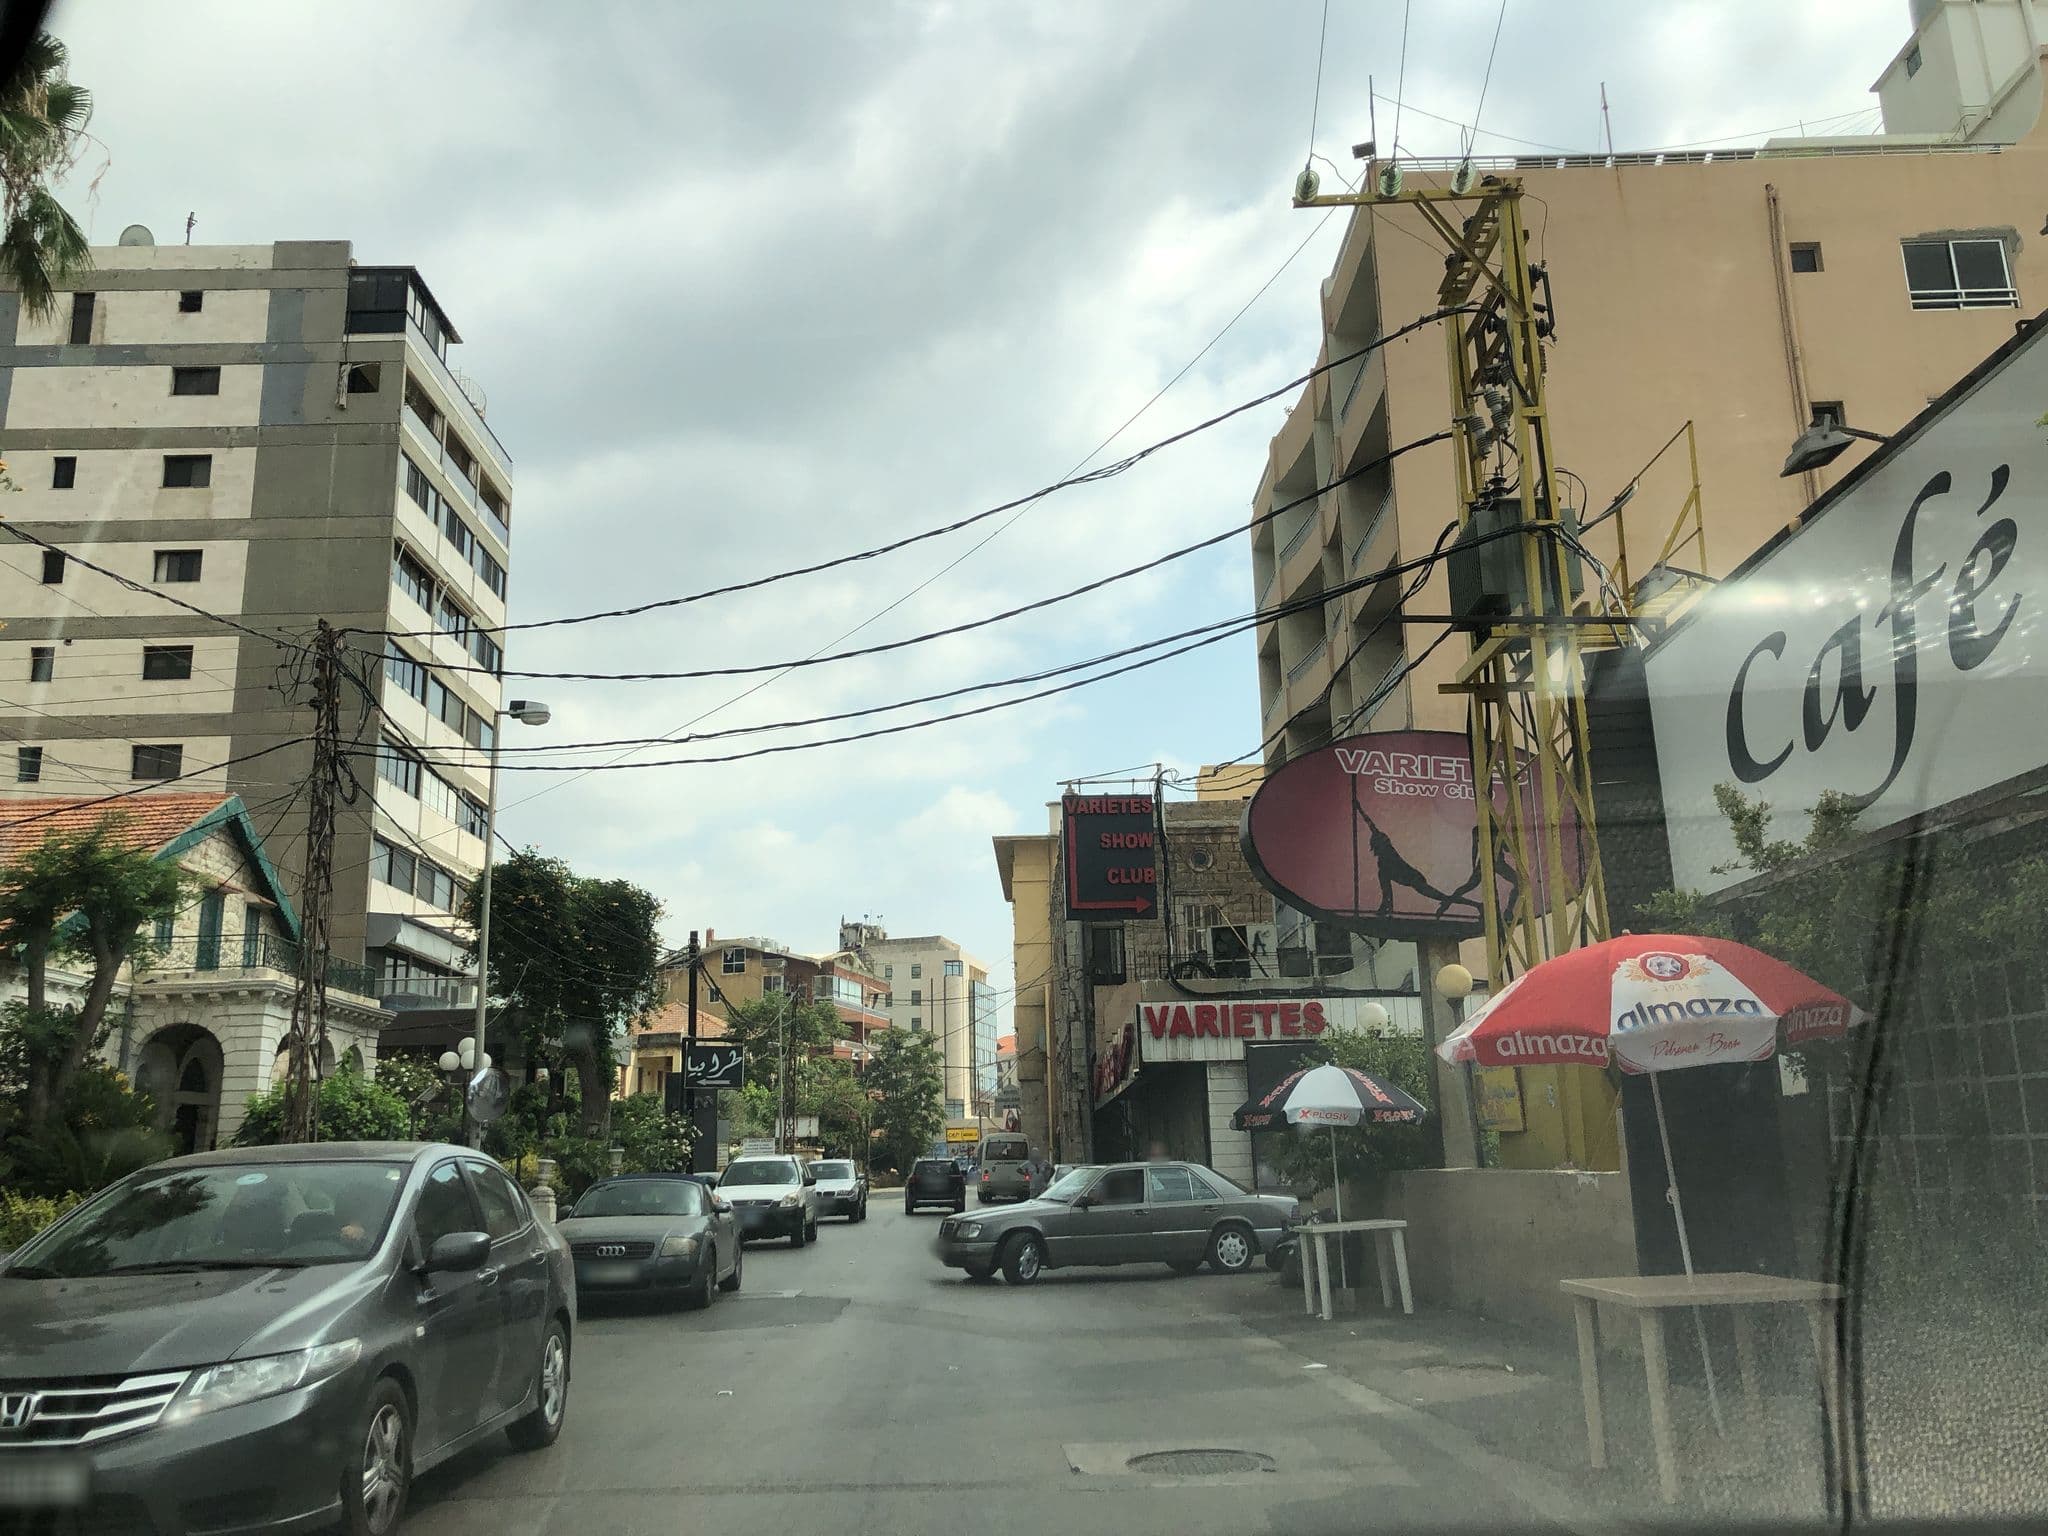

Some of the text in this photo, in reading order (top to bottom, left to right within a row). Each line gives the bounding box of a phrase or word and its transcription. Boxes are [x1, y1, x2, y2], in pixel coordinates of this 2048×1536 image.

[1726, 463, 2022, 813] café
[1374, 777, 1496, 801] Show Clu
[1064, 798, 1153, 815] VARIETES
[1100, 832, 1154, 849] SHOW
[1107, 867, 1157, 885] CLUB
[1144, 1002, 1328, 1040] VARIETES
[1617, 998, 1761, 1033] almaza
[1496, 1030, 1608, 1057] almaza
